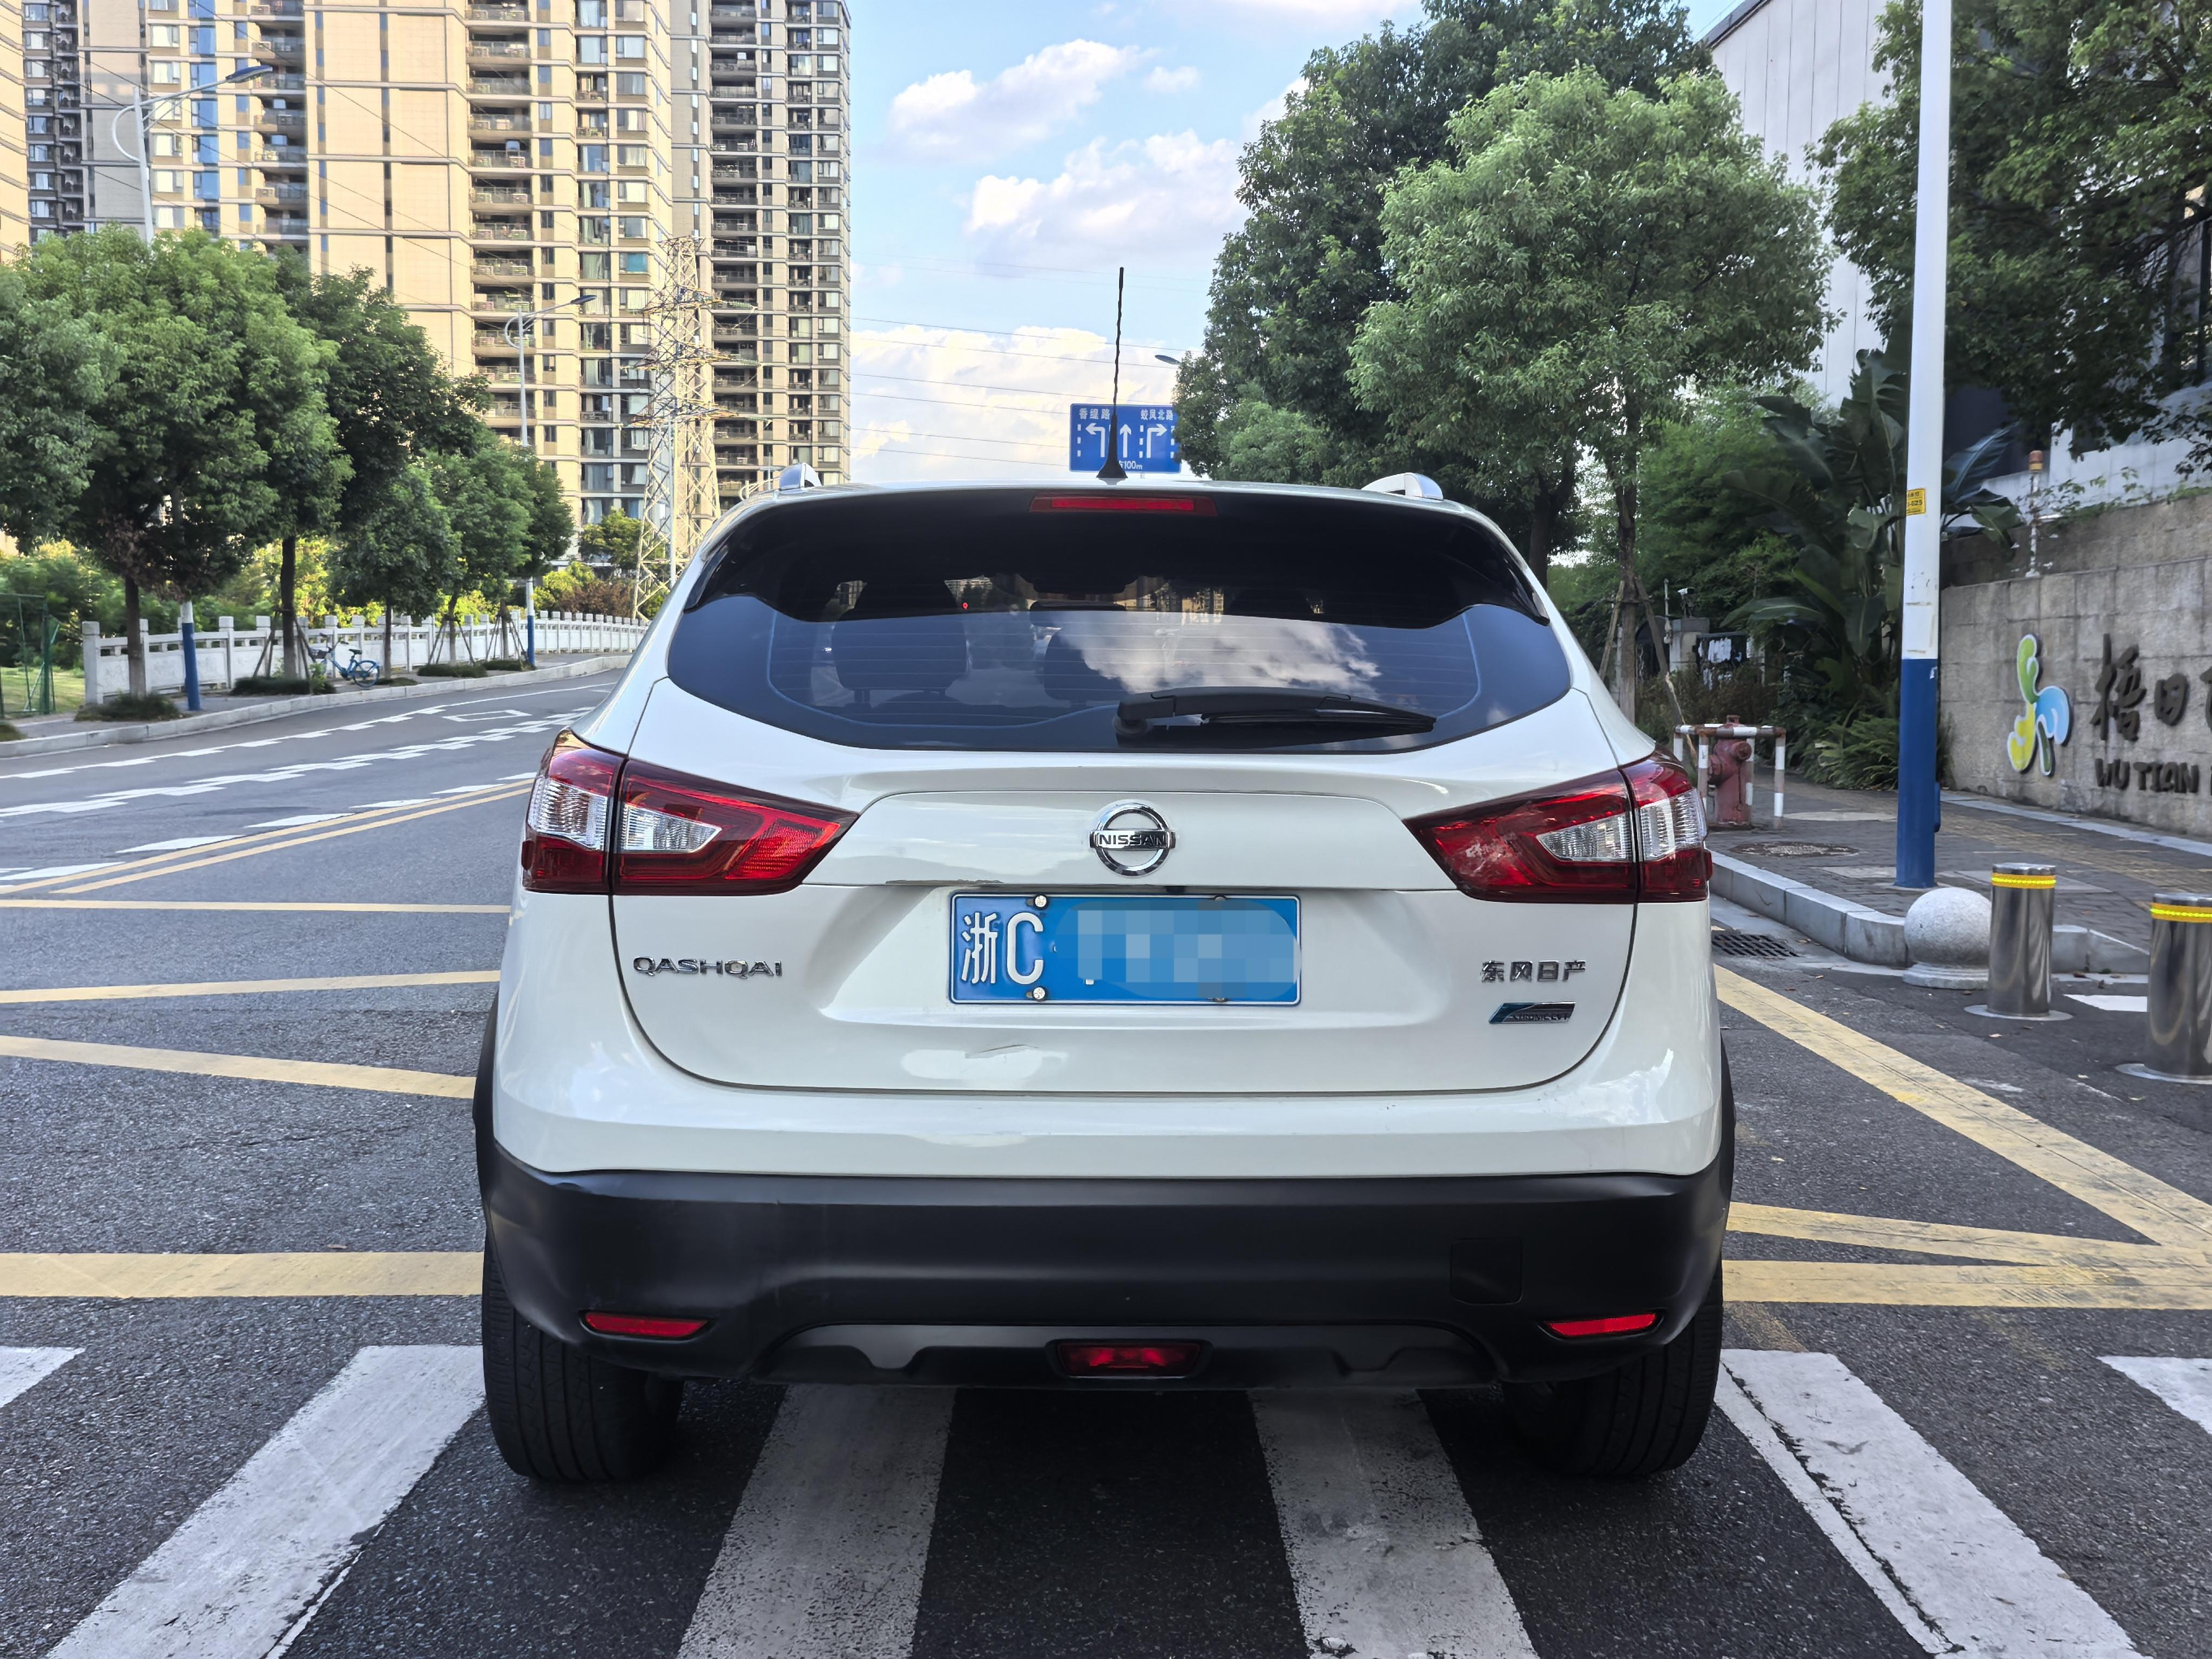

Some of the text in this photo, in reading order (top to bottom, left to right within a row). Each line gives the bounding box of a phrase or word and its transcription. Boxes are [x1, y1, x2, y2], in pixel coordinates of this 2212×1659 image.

[1099, 834, 1165, 846] NISSAN
[633, 956, 782, 979] QASHQAI
[1481, 960, 1586, 982] 东风日产
